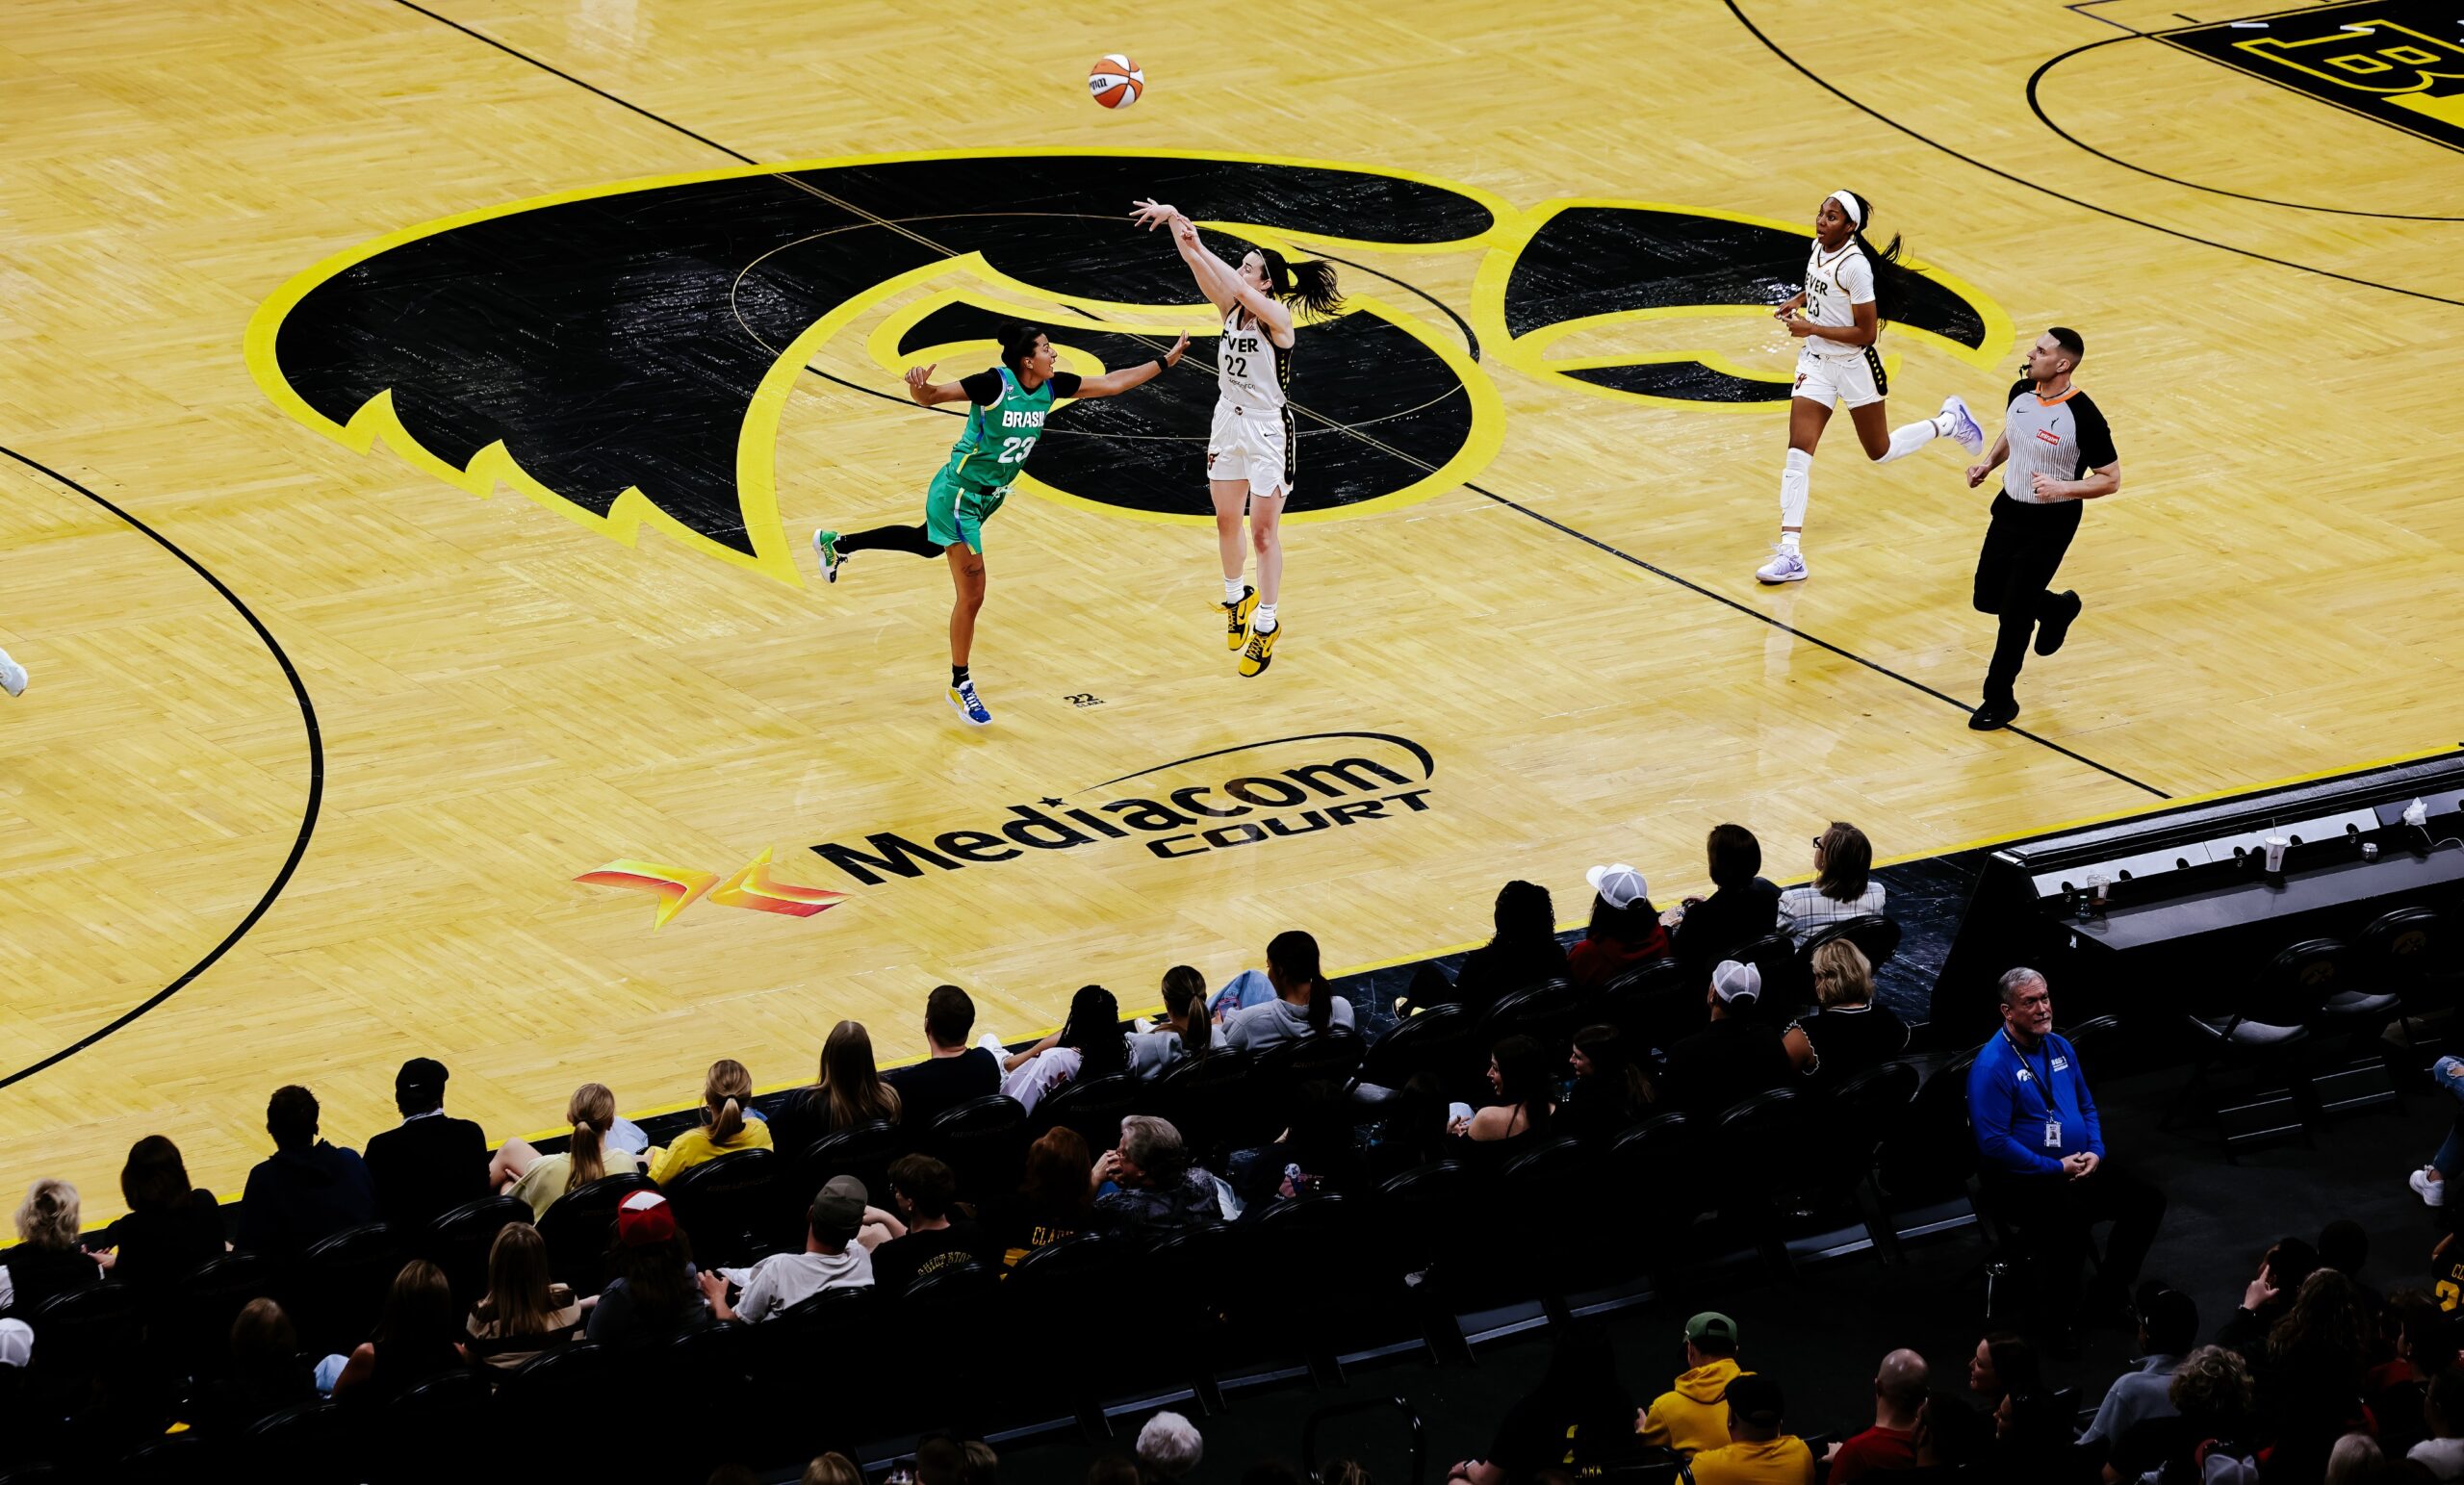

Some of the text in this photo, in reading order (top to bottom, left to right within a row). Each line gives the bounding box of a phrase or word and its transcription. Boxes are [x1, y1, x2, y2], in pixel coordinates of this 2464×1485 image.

[1805, 272, 1828, 296] EVER
[1808, 293, 1820, 318] 23
[1220, 329, 1259, 352] FVER
[1224, 354, 1247, 378] 22
[1002, 410, 1045, 428] BRASIL
[997, 436, 1037, 464] 23
[1063, 693, 1100, 704] 22
[809, 756, 1413, 886] Mediacom
[1144, 788, 1432, 859] COURT
